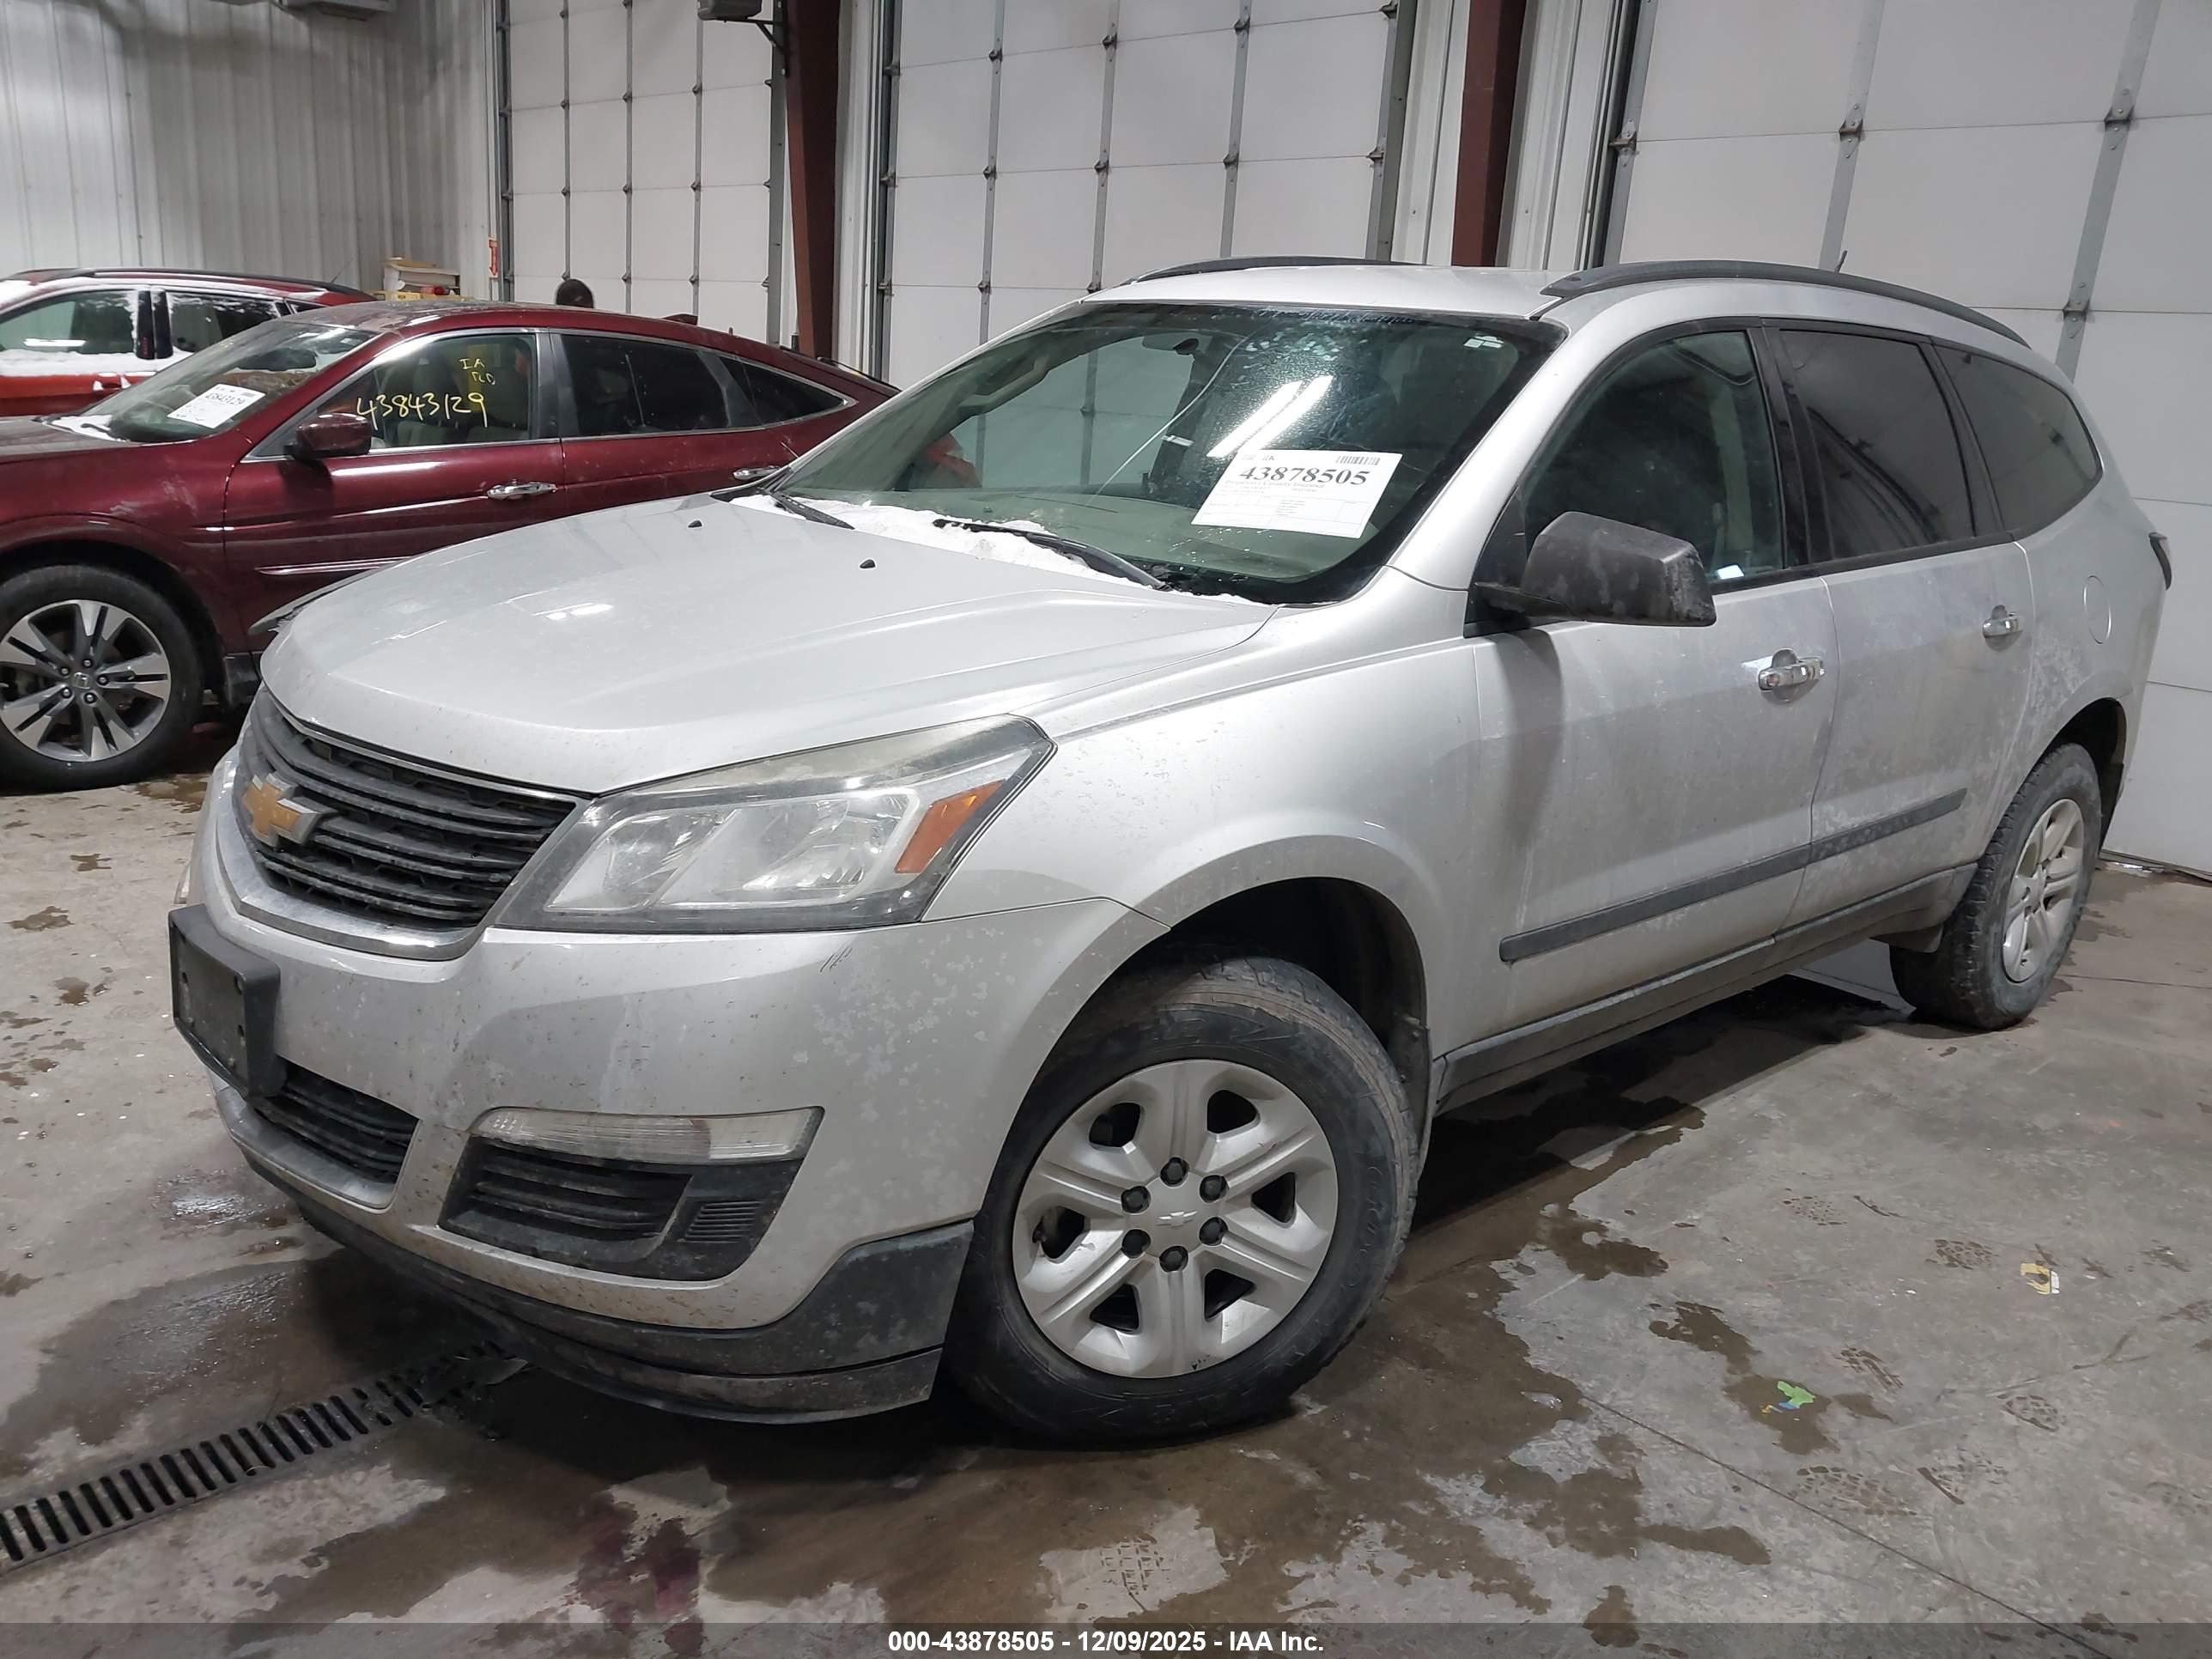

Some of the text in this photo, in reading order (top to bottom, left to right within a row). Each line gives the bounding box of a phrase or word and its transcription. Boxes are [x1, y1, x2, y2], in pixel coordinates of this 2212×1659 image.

[459, 357, 486, 370] IA
[356, 391, 489, 431] 43843129
[1239, 465, 1370, 487] 43878505
